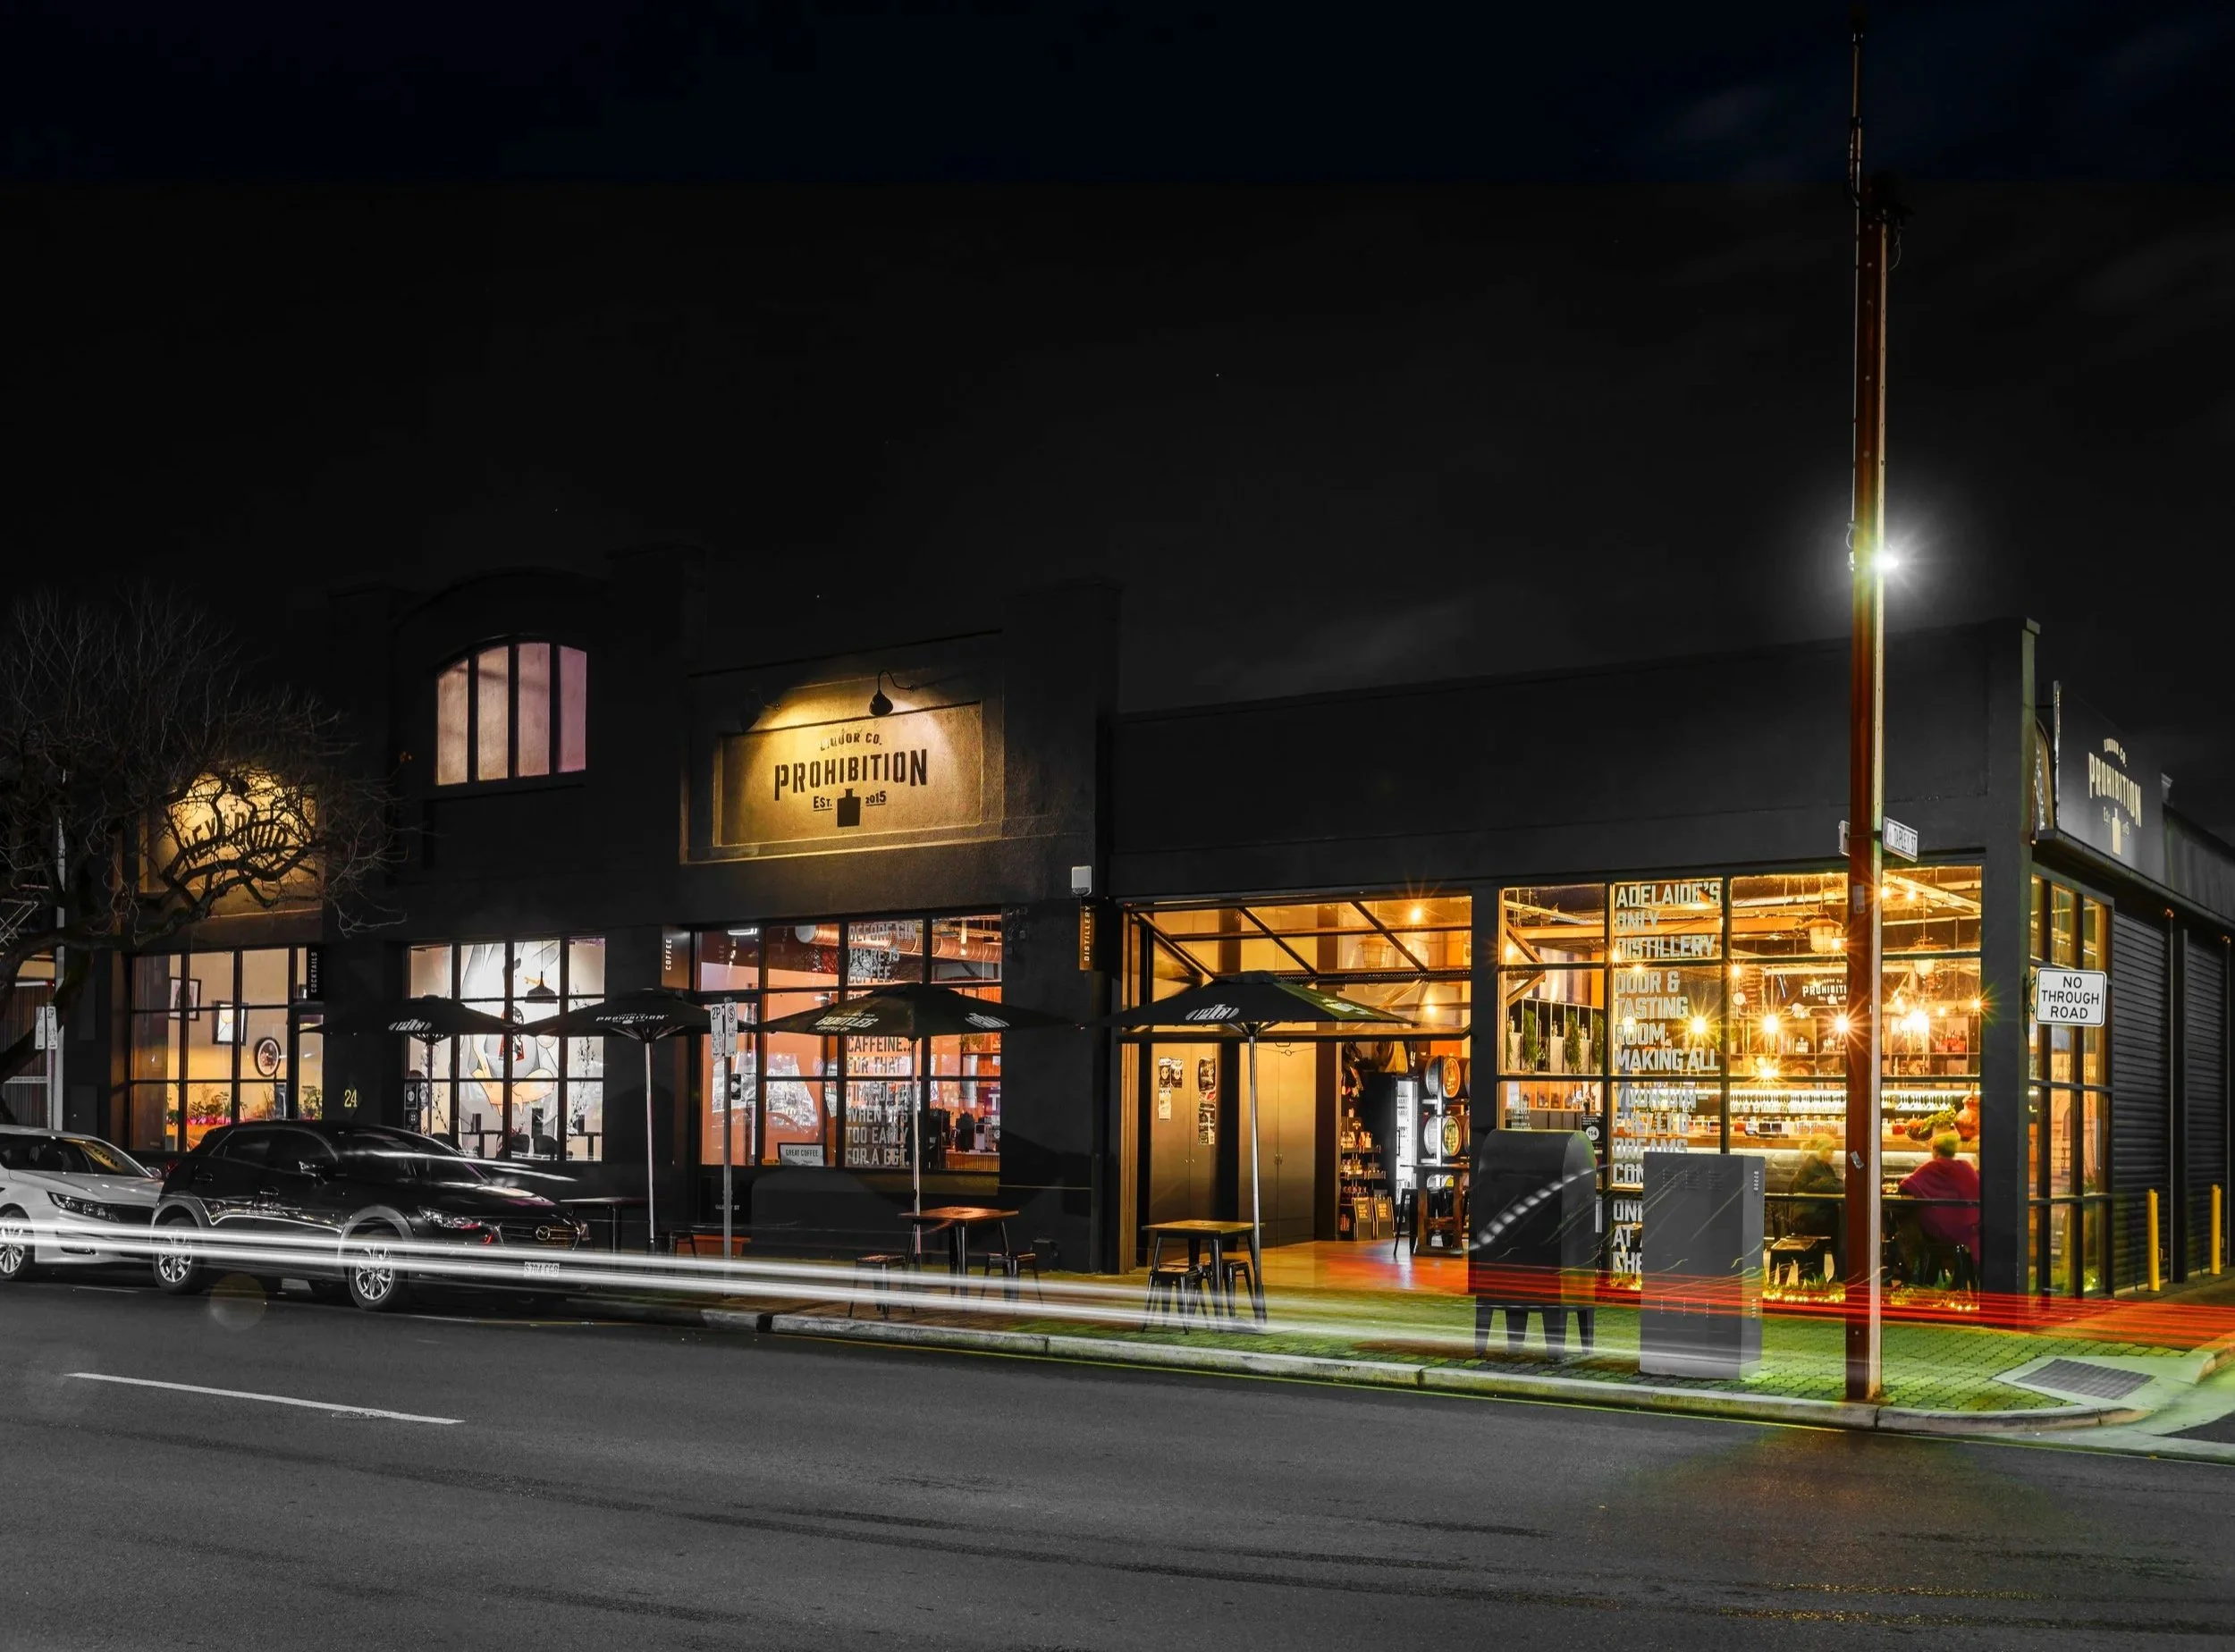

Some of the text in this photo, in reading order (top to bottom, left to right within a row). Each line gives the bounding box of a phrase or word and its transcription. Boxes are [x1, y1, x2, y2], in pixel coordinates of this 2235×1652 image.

[865, 732, 882, 746] CO.
[774, 749, 927, 801] PROHIBITION
[865, 790, 886, 805] 2015
[2088, 752, 2141, 828] PROHIBITION
[813, 796, 832, 809] EST.
[1911, 835, 1916, 854] ST
[1616, 882, 1720, 907] ADELAIDE'S
[1615, 911, 1659, 931] ONLY
[849, 922, 916, 942] BEFORE GIN
[849, 948, 885, 964] THERE
[1615, 935, 1716, 960] DISTILLERY
[1615, 971, 1681, 993] DOOR &
[2062, 976, 2082, 989] NO
[1802, 985, 1847, 998] PROHIBITI
[2042, 990, 2100, 1005] THROUGH
[712, 1007, 721, 1020] 2P
[1615, 997, 1689, 1018] TASTING
[2051, 1007, 2088, 1019] ROAD
[848, 1056, 903, 1074] FOR THAT
[1615, 1049, 1720, 1071] MAKING ALL
[344, 1089, 358, 1108] 24
[1615, 1088, 1660, 1108] YOUR
[847, 1106, 882, 1123] WHEN
[1615, 1113, 1690, 1134] FUELLED
[846, 1127, 908, 1144] TOO EARLY
[1588, 1129, 1598, 1137] 114
[785, 1148, 819, 1158] GREAT COFFEE
[845, 1148, 867, 1165] FOR
[871, 1148, 880, 1166] A
[1613, 1138, 1689, 1159] DREAMS
[1612, 1226, 1632, 1248] AT
